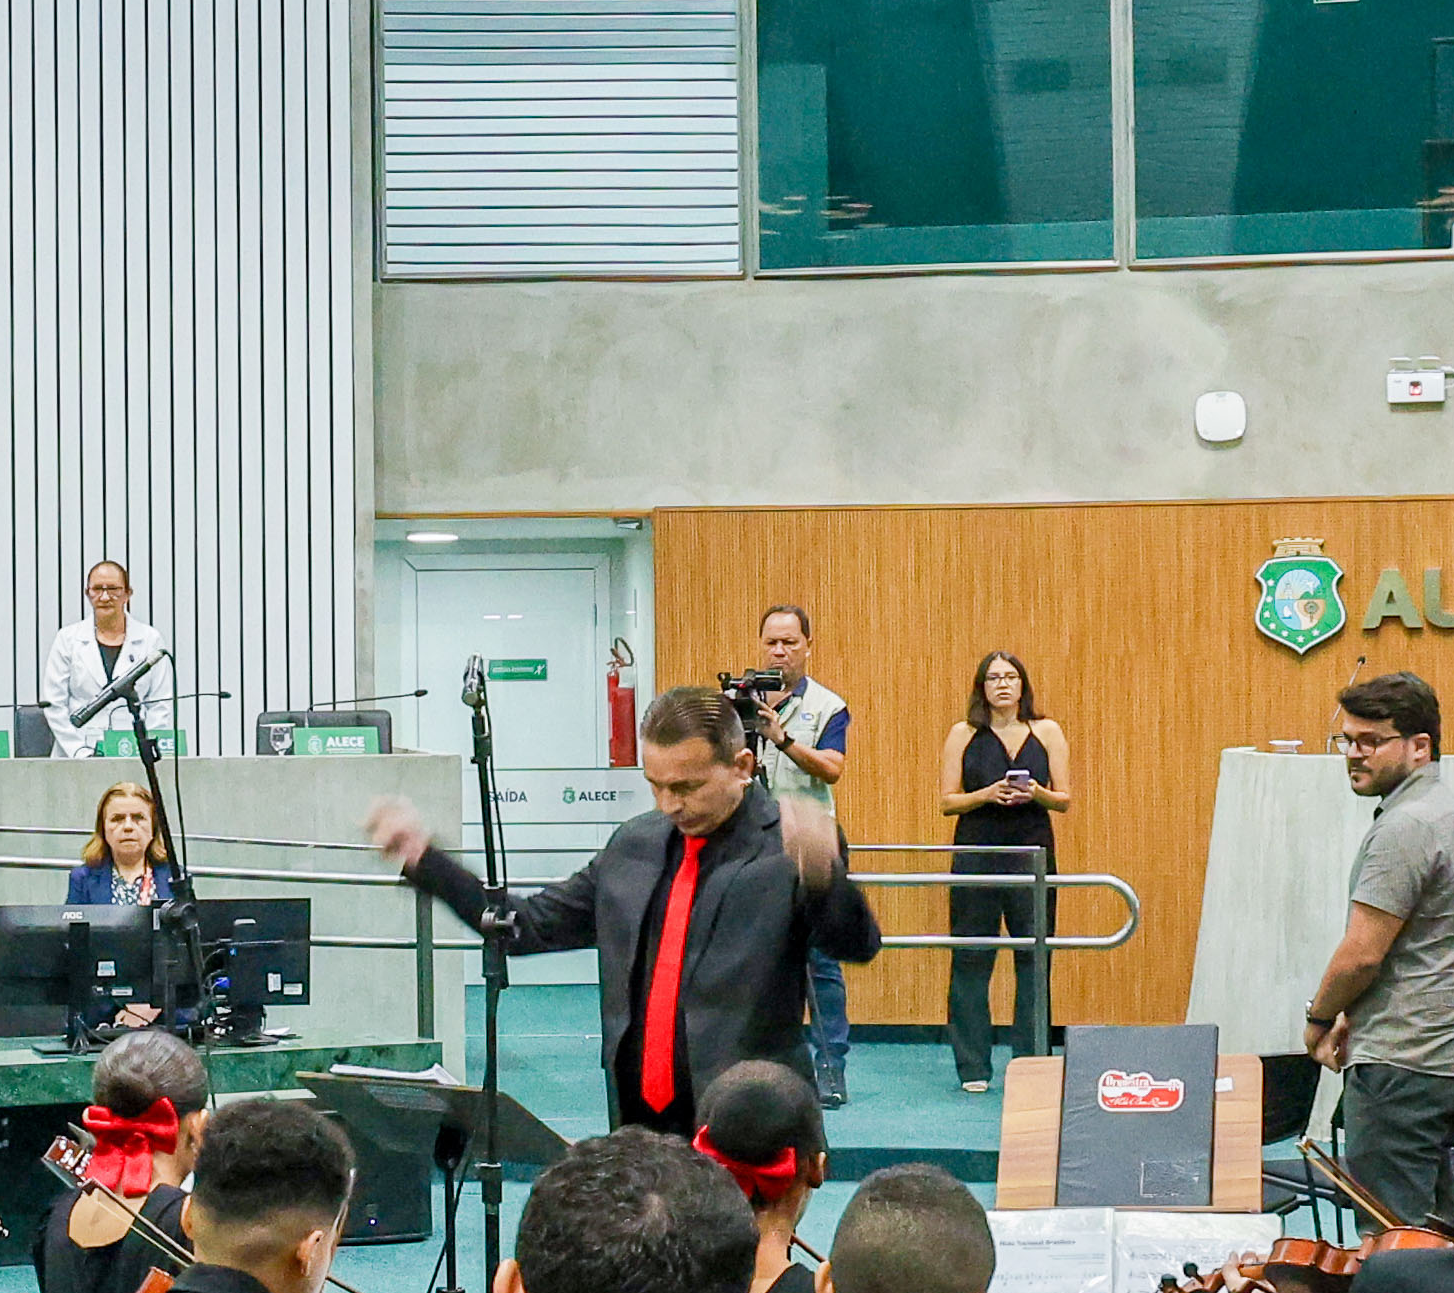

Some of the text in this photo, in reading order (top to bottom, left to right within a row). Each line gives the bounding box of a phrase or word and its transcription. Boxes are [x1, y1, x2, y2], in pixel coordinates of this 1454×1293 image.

[326, 736, 365, 748] ALECE
[578, 791, 617, 801] ALECE
[62, 911, 83, 920] AOC
